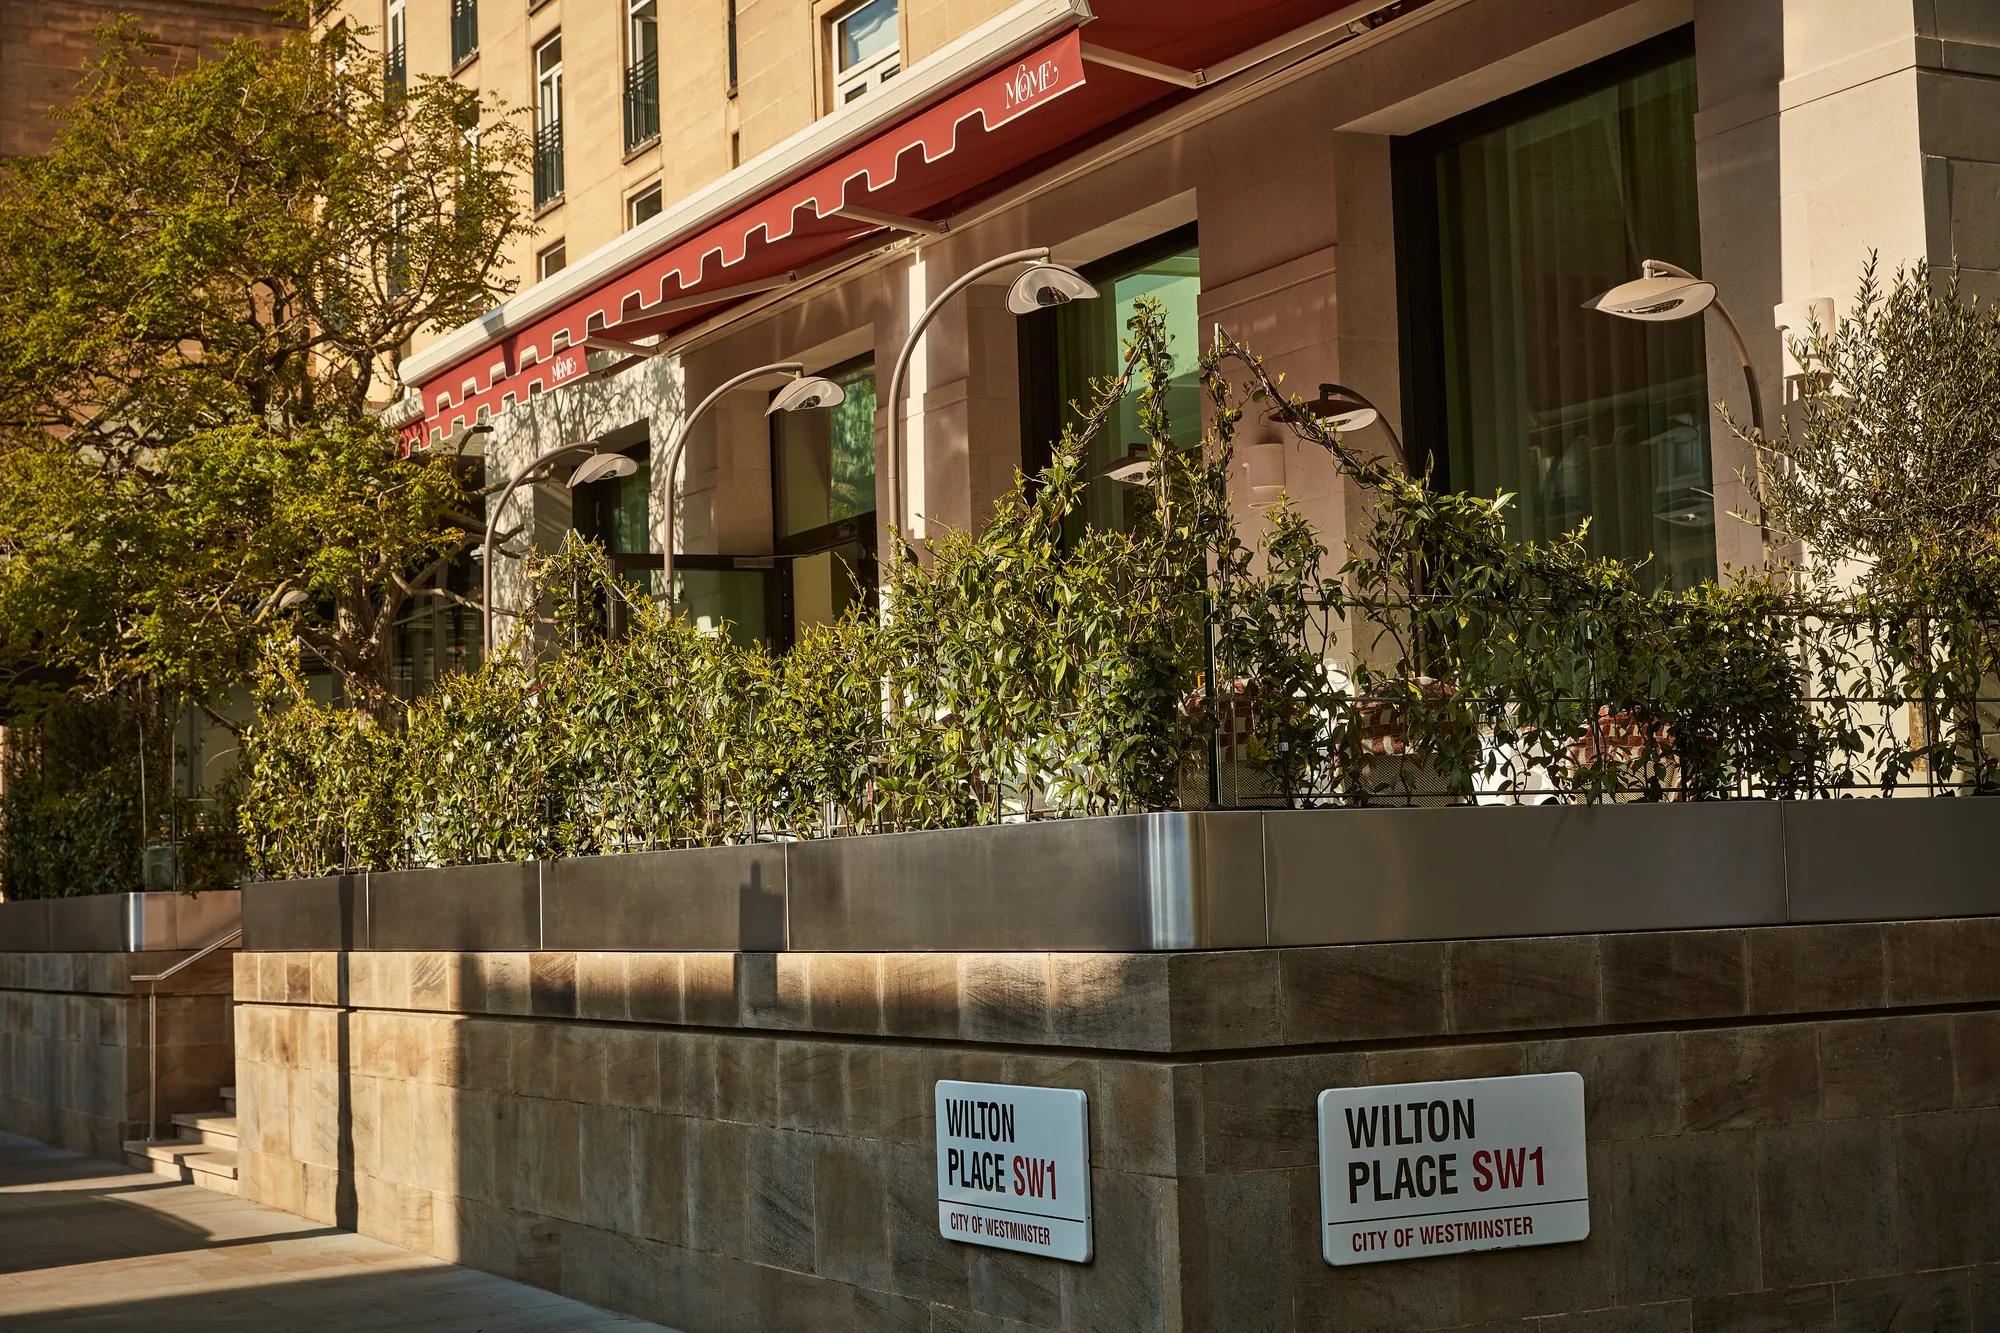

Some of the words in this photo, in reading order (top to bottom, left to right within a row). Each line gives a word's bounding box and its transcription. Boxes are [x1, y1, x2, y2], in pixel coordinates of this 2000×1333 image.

[945, 1098, 1016, 1144] WILTON
[1344, 1098, 1476, 1149] WILTON
[947, 1147, 1007, 1194] PLACE
[1012, 1155, 1057, 1200] SW1
[1348, 1153, 1459, 1204] PLACE
[1472, 1146, 1545, 1193] SW1
[950, 1212, 969, 1233] CITY
[971, 1214, 983, 1235] OF
[985, 1217, 1051, 1246] WESTMINSTER
[1352, 1230, 1388, 1253] CITY
[1393, 1227, 1414, 1249] OF
[1419, 1216, 1534, 1246] WESTMINSTER
